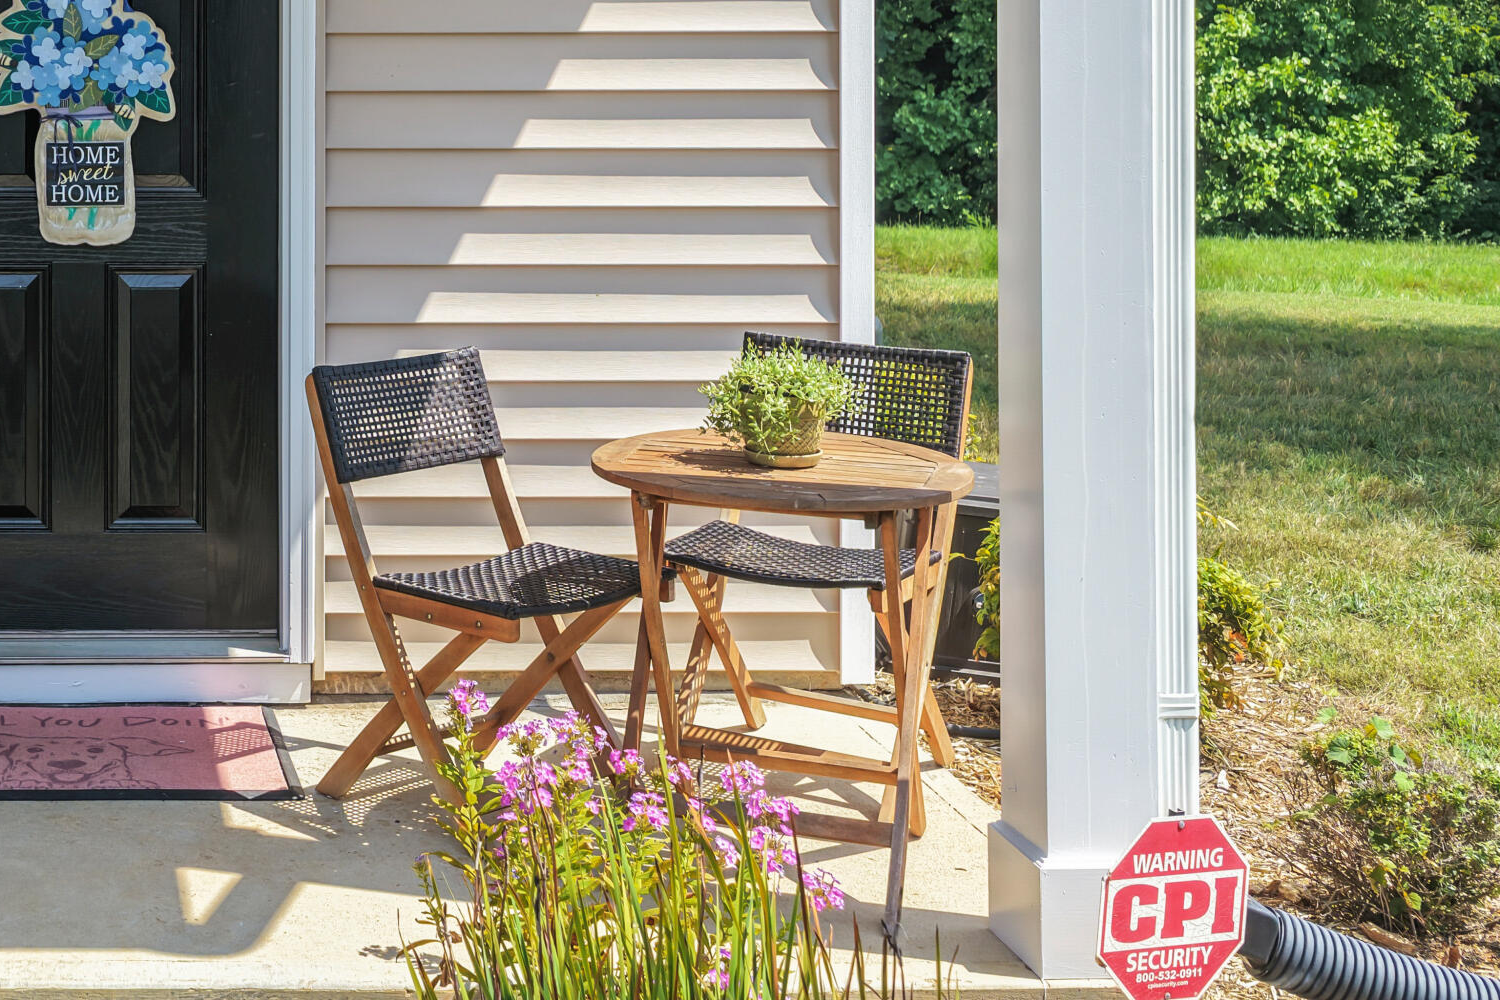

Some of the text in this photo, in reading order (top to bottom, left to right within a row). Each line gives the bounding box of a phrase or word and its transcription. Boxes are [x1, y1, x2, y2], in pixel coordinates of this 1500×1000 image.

[52, 146, 120, 164] HOME
[57, 162, 114, 185] sweet
[51, 185, 120, 203] HOME
[32, 715, 102, 727] YOU
[1133, 847, 1223, 874] WARNING
[1111, 876, 1238, 943] CPI
[1126, 945, 1213, 973] SECURITY
[1135, 967, 1202, 983] 800-532-0911
